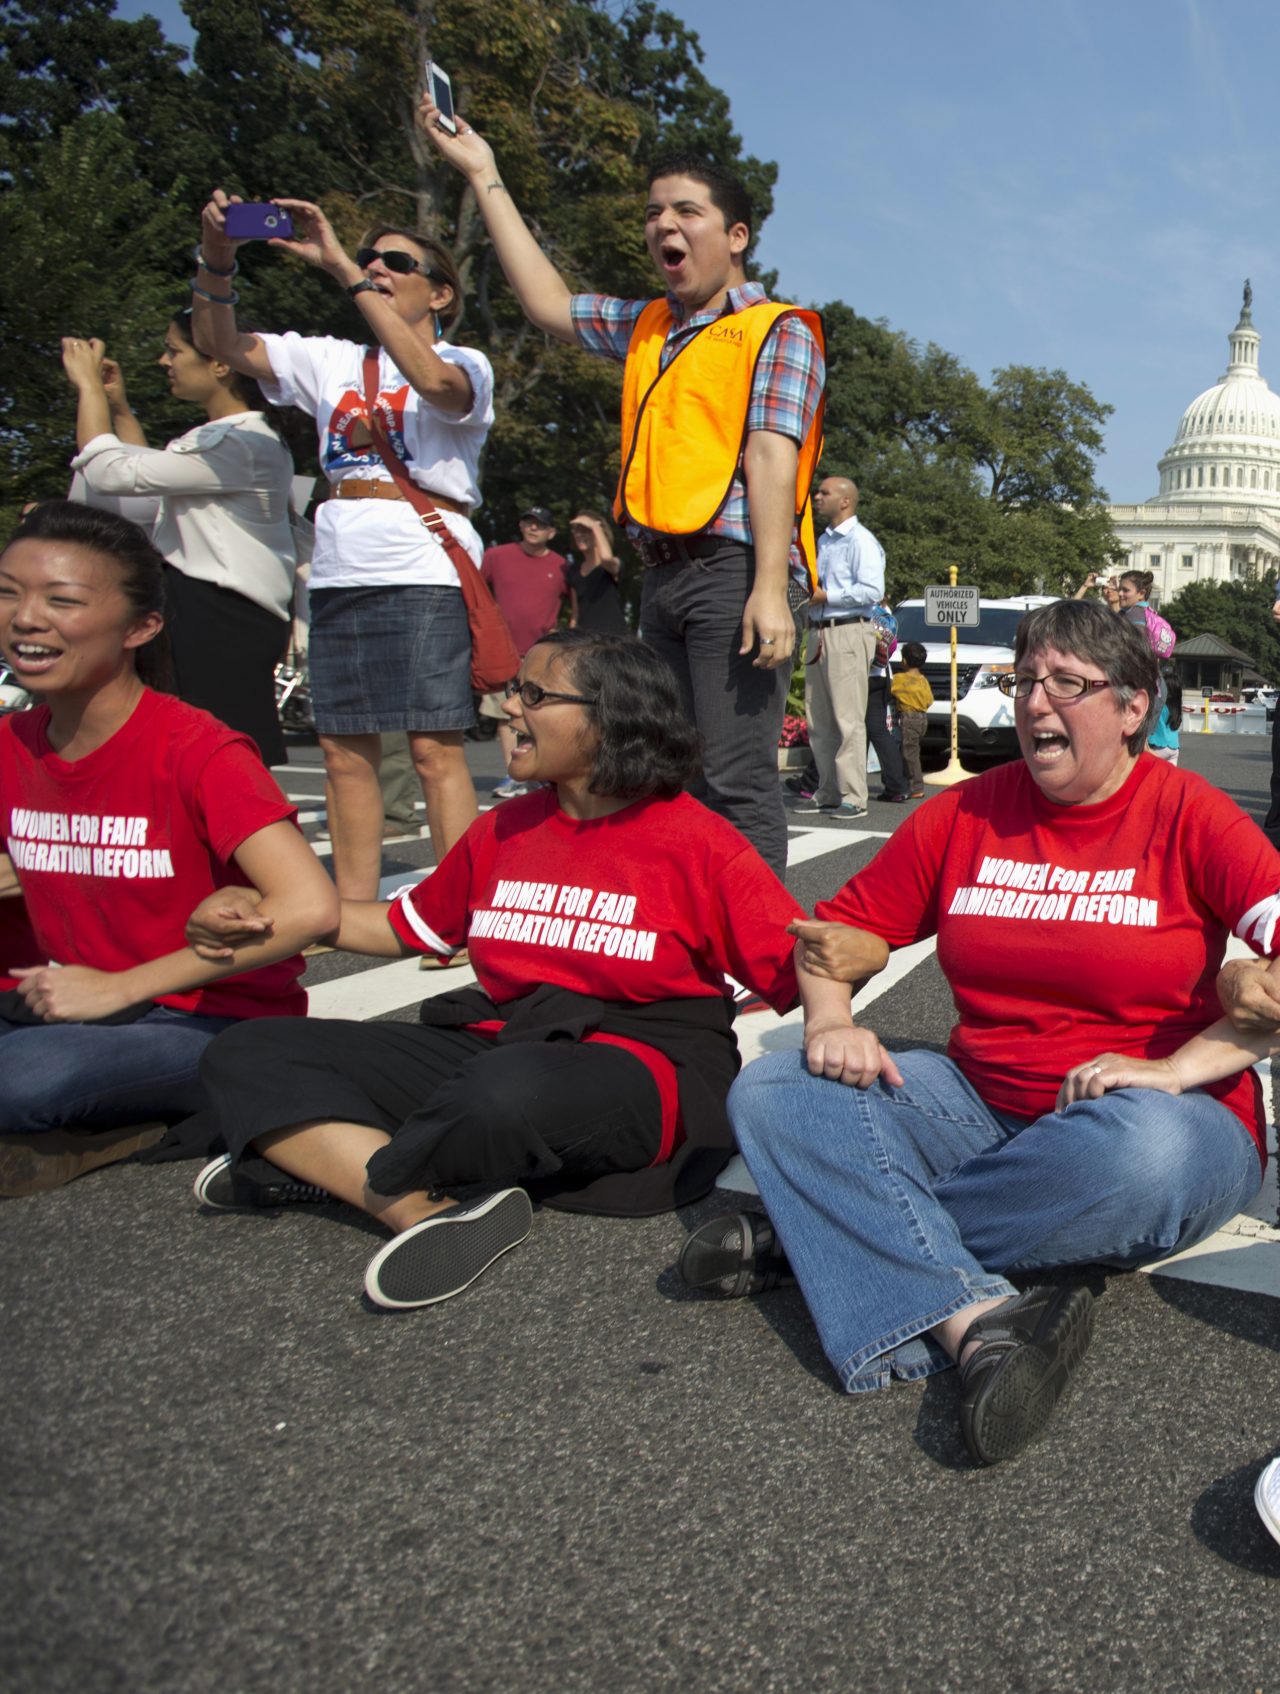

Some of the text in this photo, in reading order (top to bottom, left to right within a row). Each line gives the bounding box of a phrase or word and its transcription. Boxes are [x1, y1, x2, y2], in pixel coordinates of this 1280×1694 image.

[709, 325, 743, 341] CASA
[930, 589, 974, 599] AUTHORIZED
[936, 601, 968, 610] VEHICLES
[937, 610, 967, 623] ONLY
[11, 808, 149, 846] WOMEN FOR FAIR
[93, 848, 175, 879] REFORM
[976, 856, 1136, 893] WOMEN FOR FAIR
[491, 879, 637, 925] WOMEN FOR FAIR
[948, 886, 1158, 927] IMMIGRATION REFORM
[572, 921, 658, 962] REFORM
